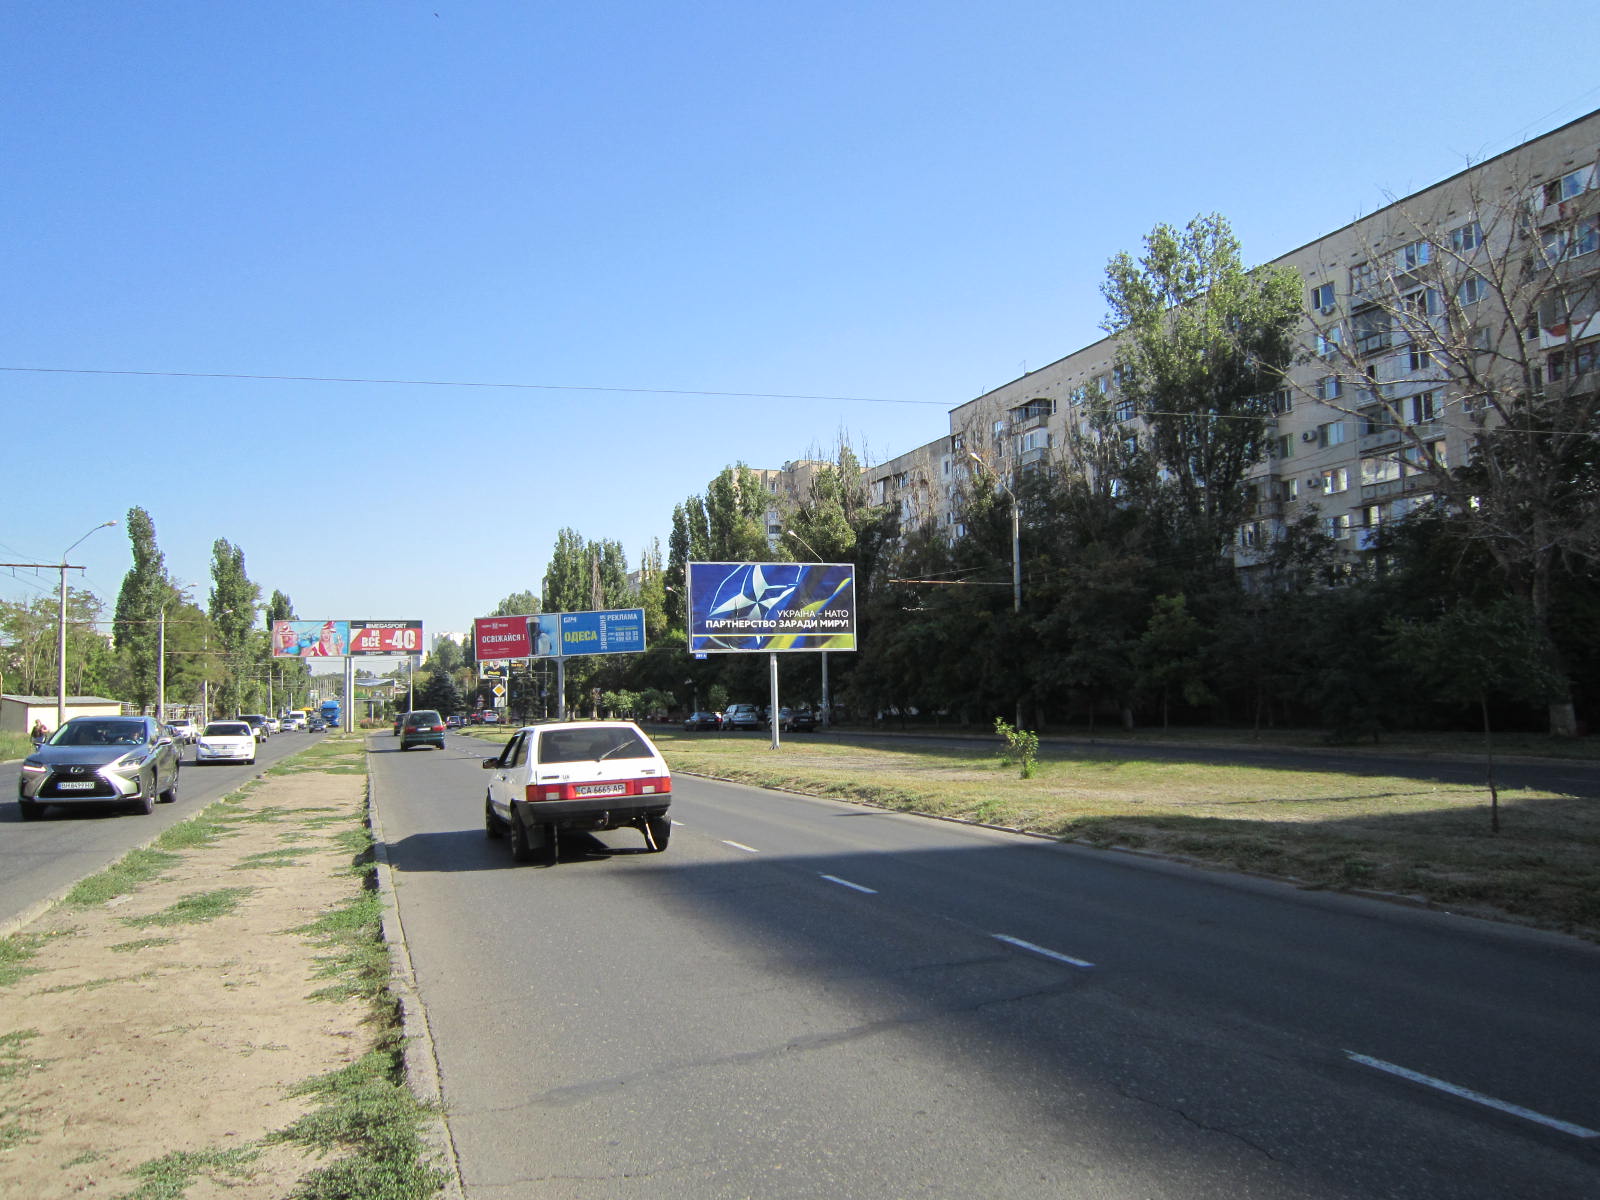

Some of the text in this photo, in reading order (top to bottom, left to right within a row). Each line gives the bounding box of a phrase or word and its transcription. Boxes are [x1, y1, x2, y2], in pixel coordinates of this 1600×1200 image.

[607, 613, 638, 621] РЕКЛАМА
[777, 608, 815, 618] УКРАЇНА
[825, 610, 849, 618] НАТО
[705, 620, 849, 629] ПАРТНЕРСТВО ЗАРАДИ МИРУ!
[361, 637, 380, 647] ВСЕ
[482, 633, 521, 643] ОСВІЖАЙСЯ
[564, 631, 598, 643] ОДЕСА
